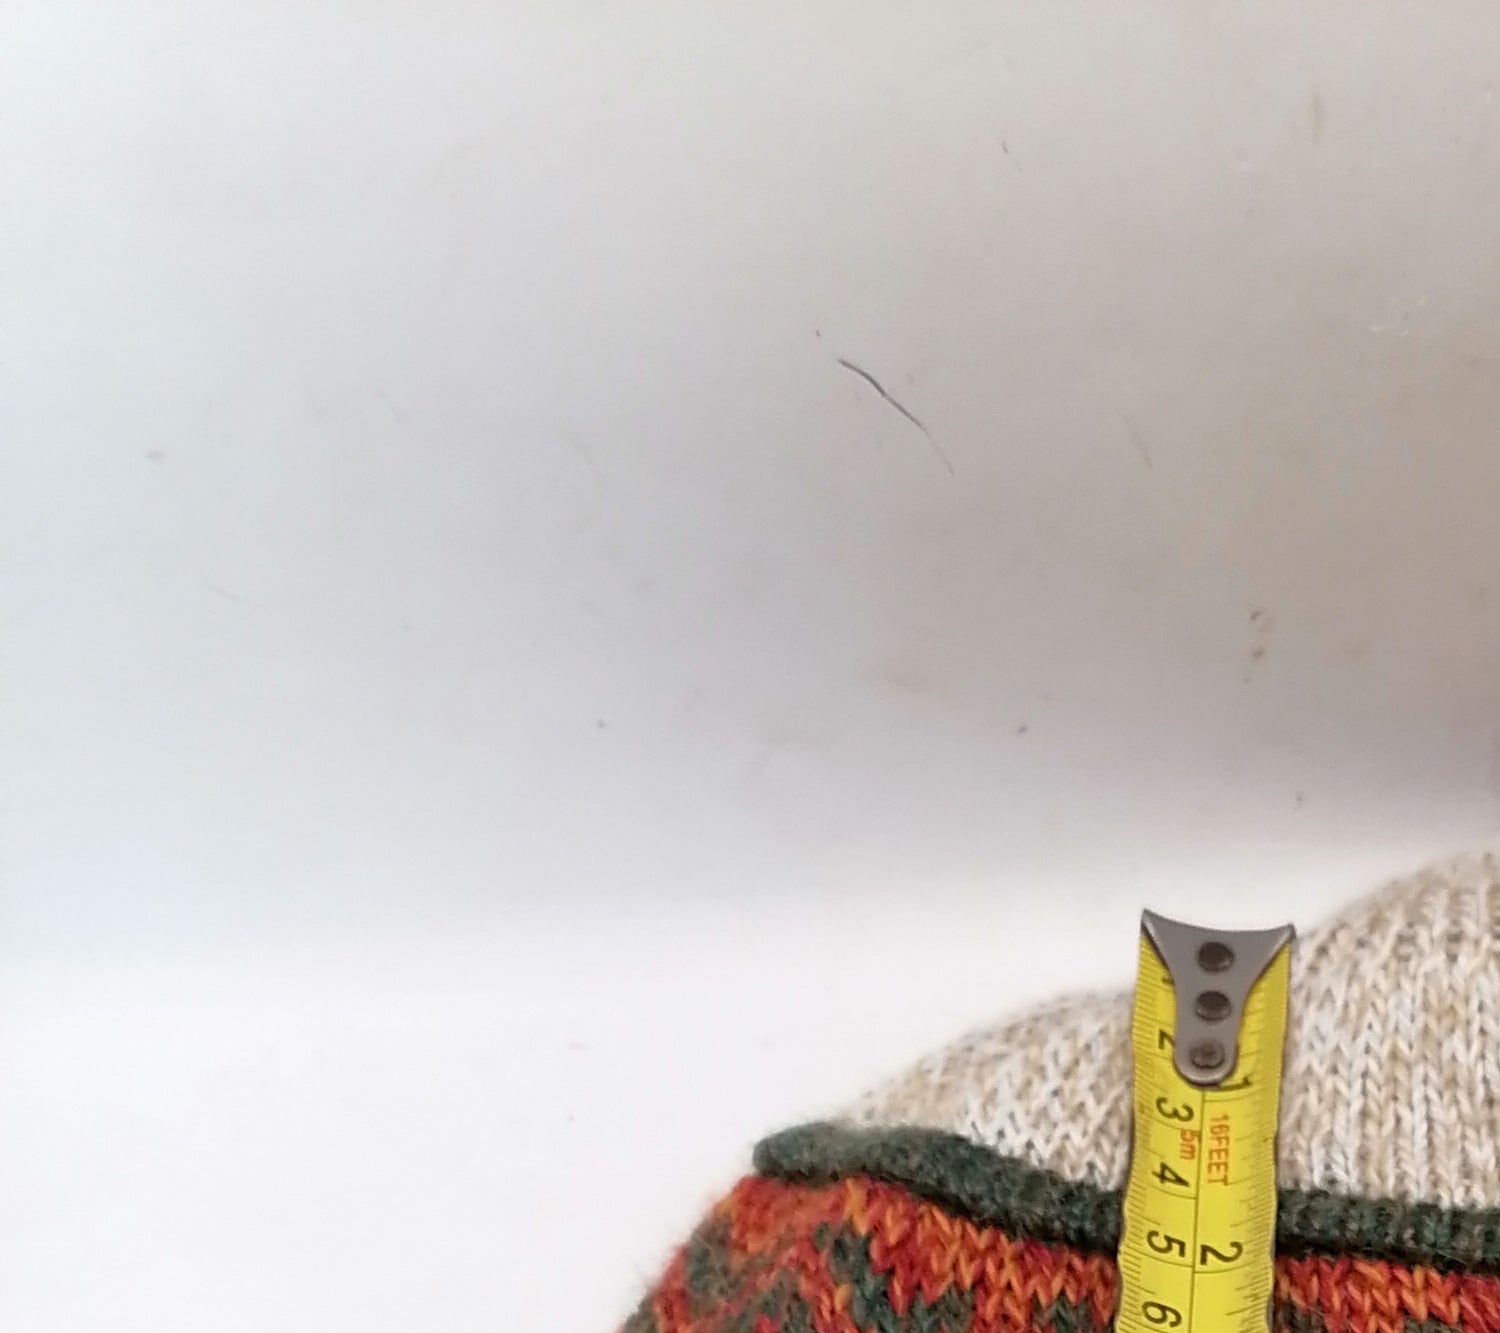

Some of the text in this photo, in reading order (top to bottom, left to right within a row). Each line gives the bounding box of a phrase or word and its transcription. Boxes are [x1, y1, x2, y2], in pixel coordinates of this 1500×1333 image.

[1156, 1097, 1194, 1123] 3
[1179, 1128, 1200, 1160] 5m
[1152, 1162, 1190, 1187] 4
[1146, 1230, 1187, 1259] 5
[1200, 1241, 1243, 1265] 2
[1141, 1301, 1182, 1328] 6
